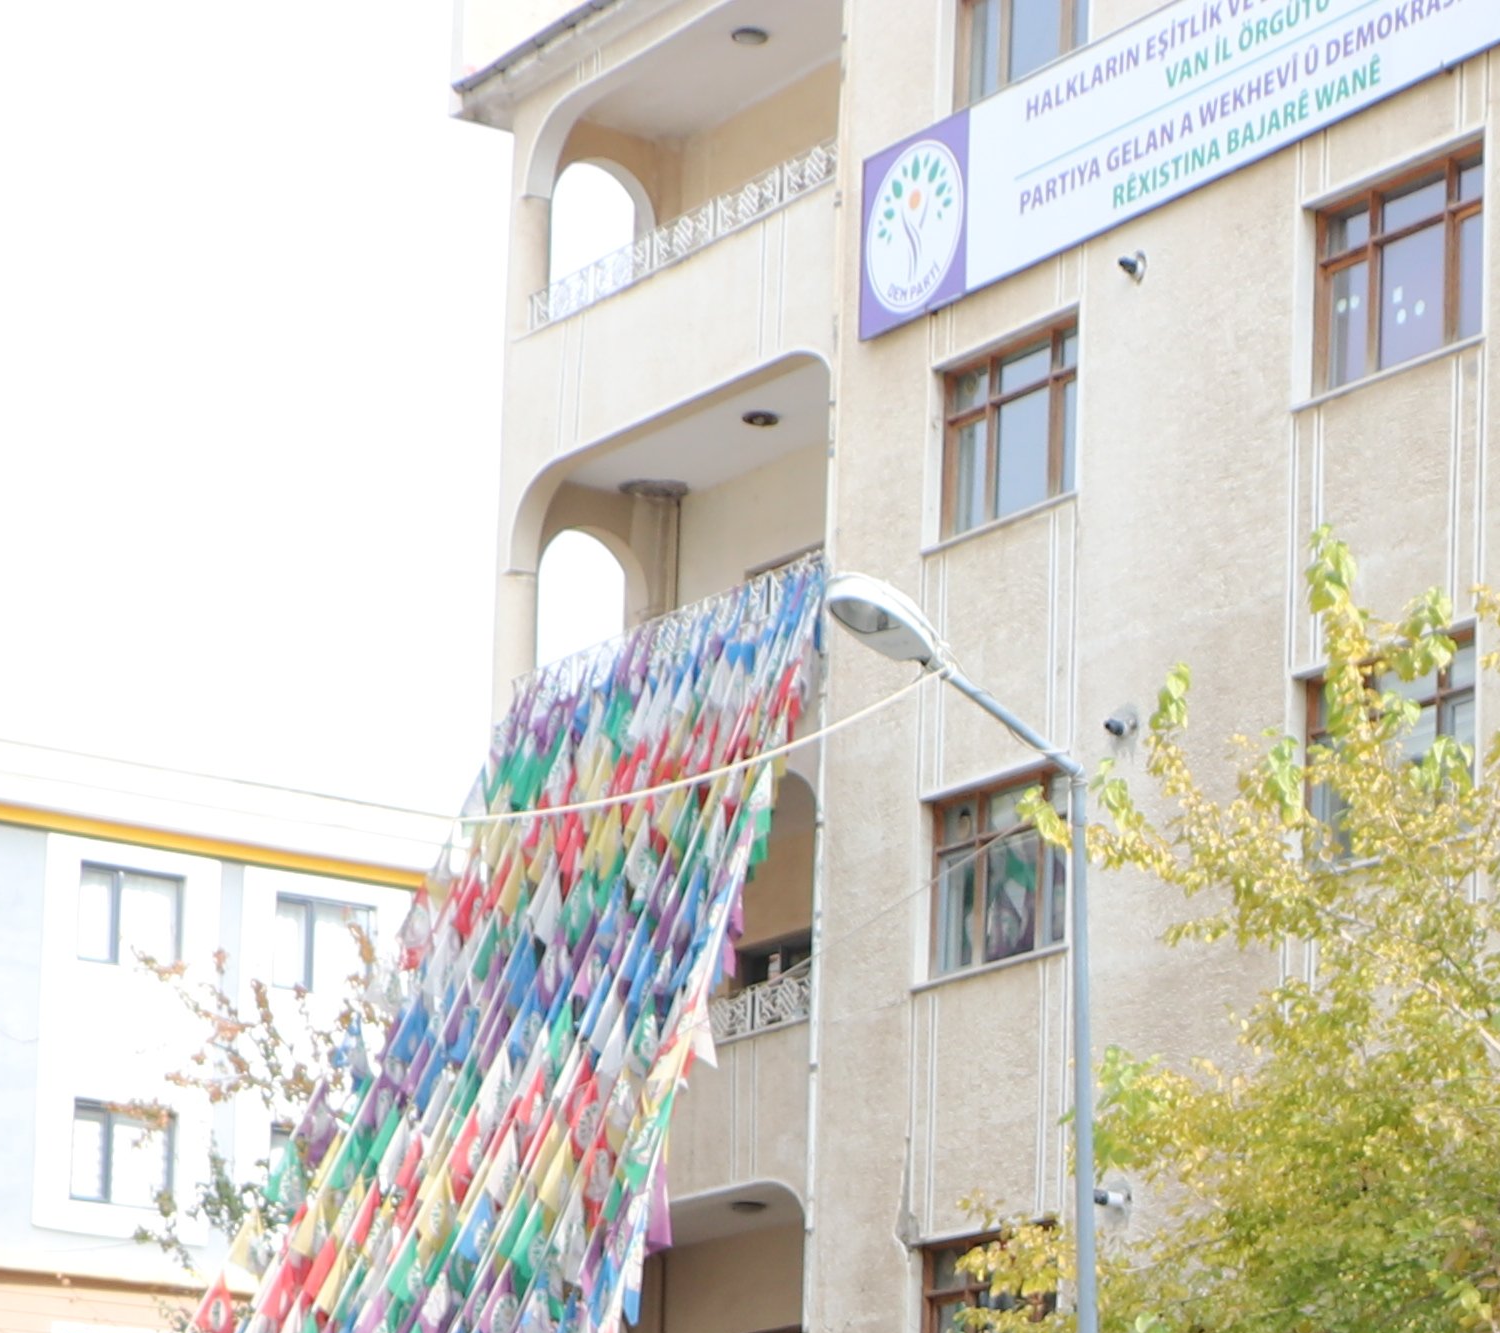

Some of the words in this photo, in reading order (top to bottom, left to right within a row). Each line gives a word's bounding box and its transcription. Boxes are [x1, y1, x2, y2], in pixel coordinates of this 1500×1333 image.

[1025, 43, 1140, 122] HALKLARIN
[1145, 0, 1222, 61] EŞİTLİK
[1106, 119, 1175, 173] GELAN
[1178, 111, 1194, 139] A
[1304, 43, 1320, 77] Û
[1165, 51, 1208, 89] VAN
[1214, 33, 1232, 66] İL
[1112, 137, 1221, 210] RÊXISTINA
[1226, 89, 1310, 157] BAJARÊ
[1313, 53, 1382, 113] WANÊ
